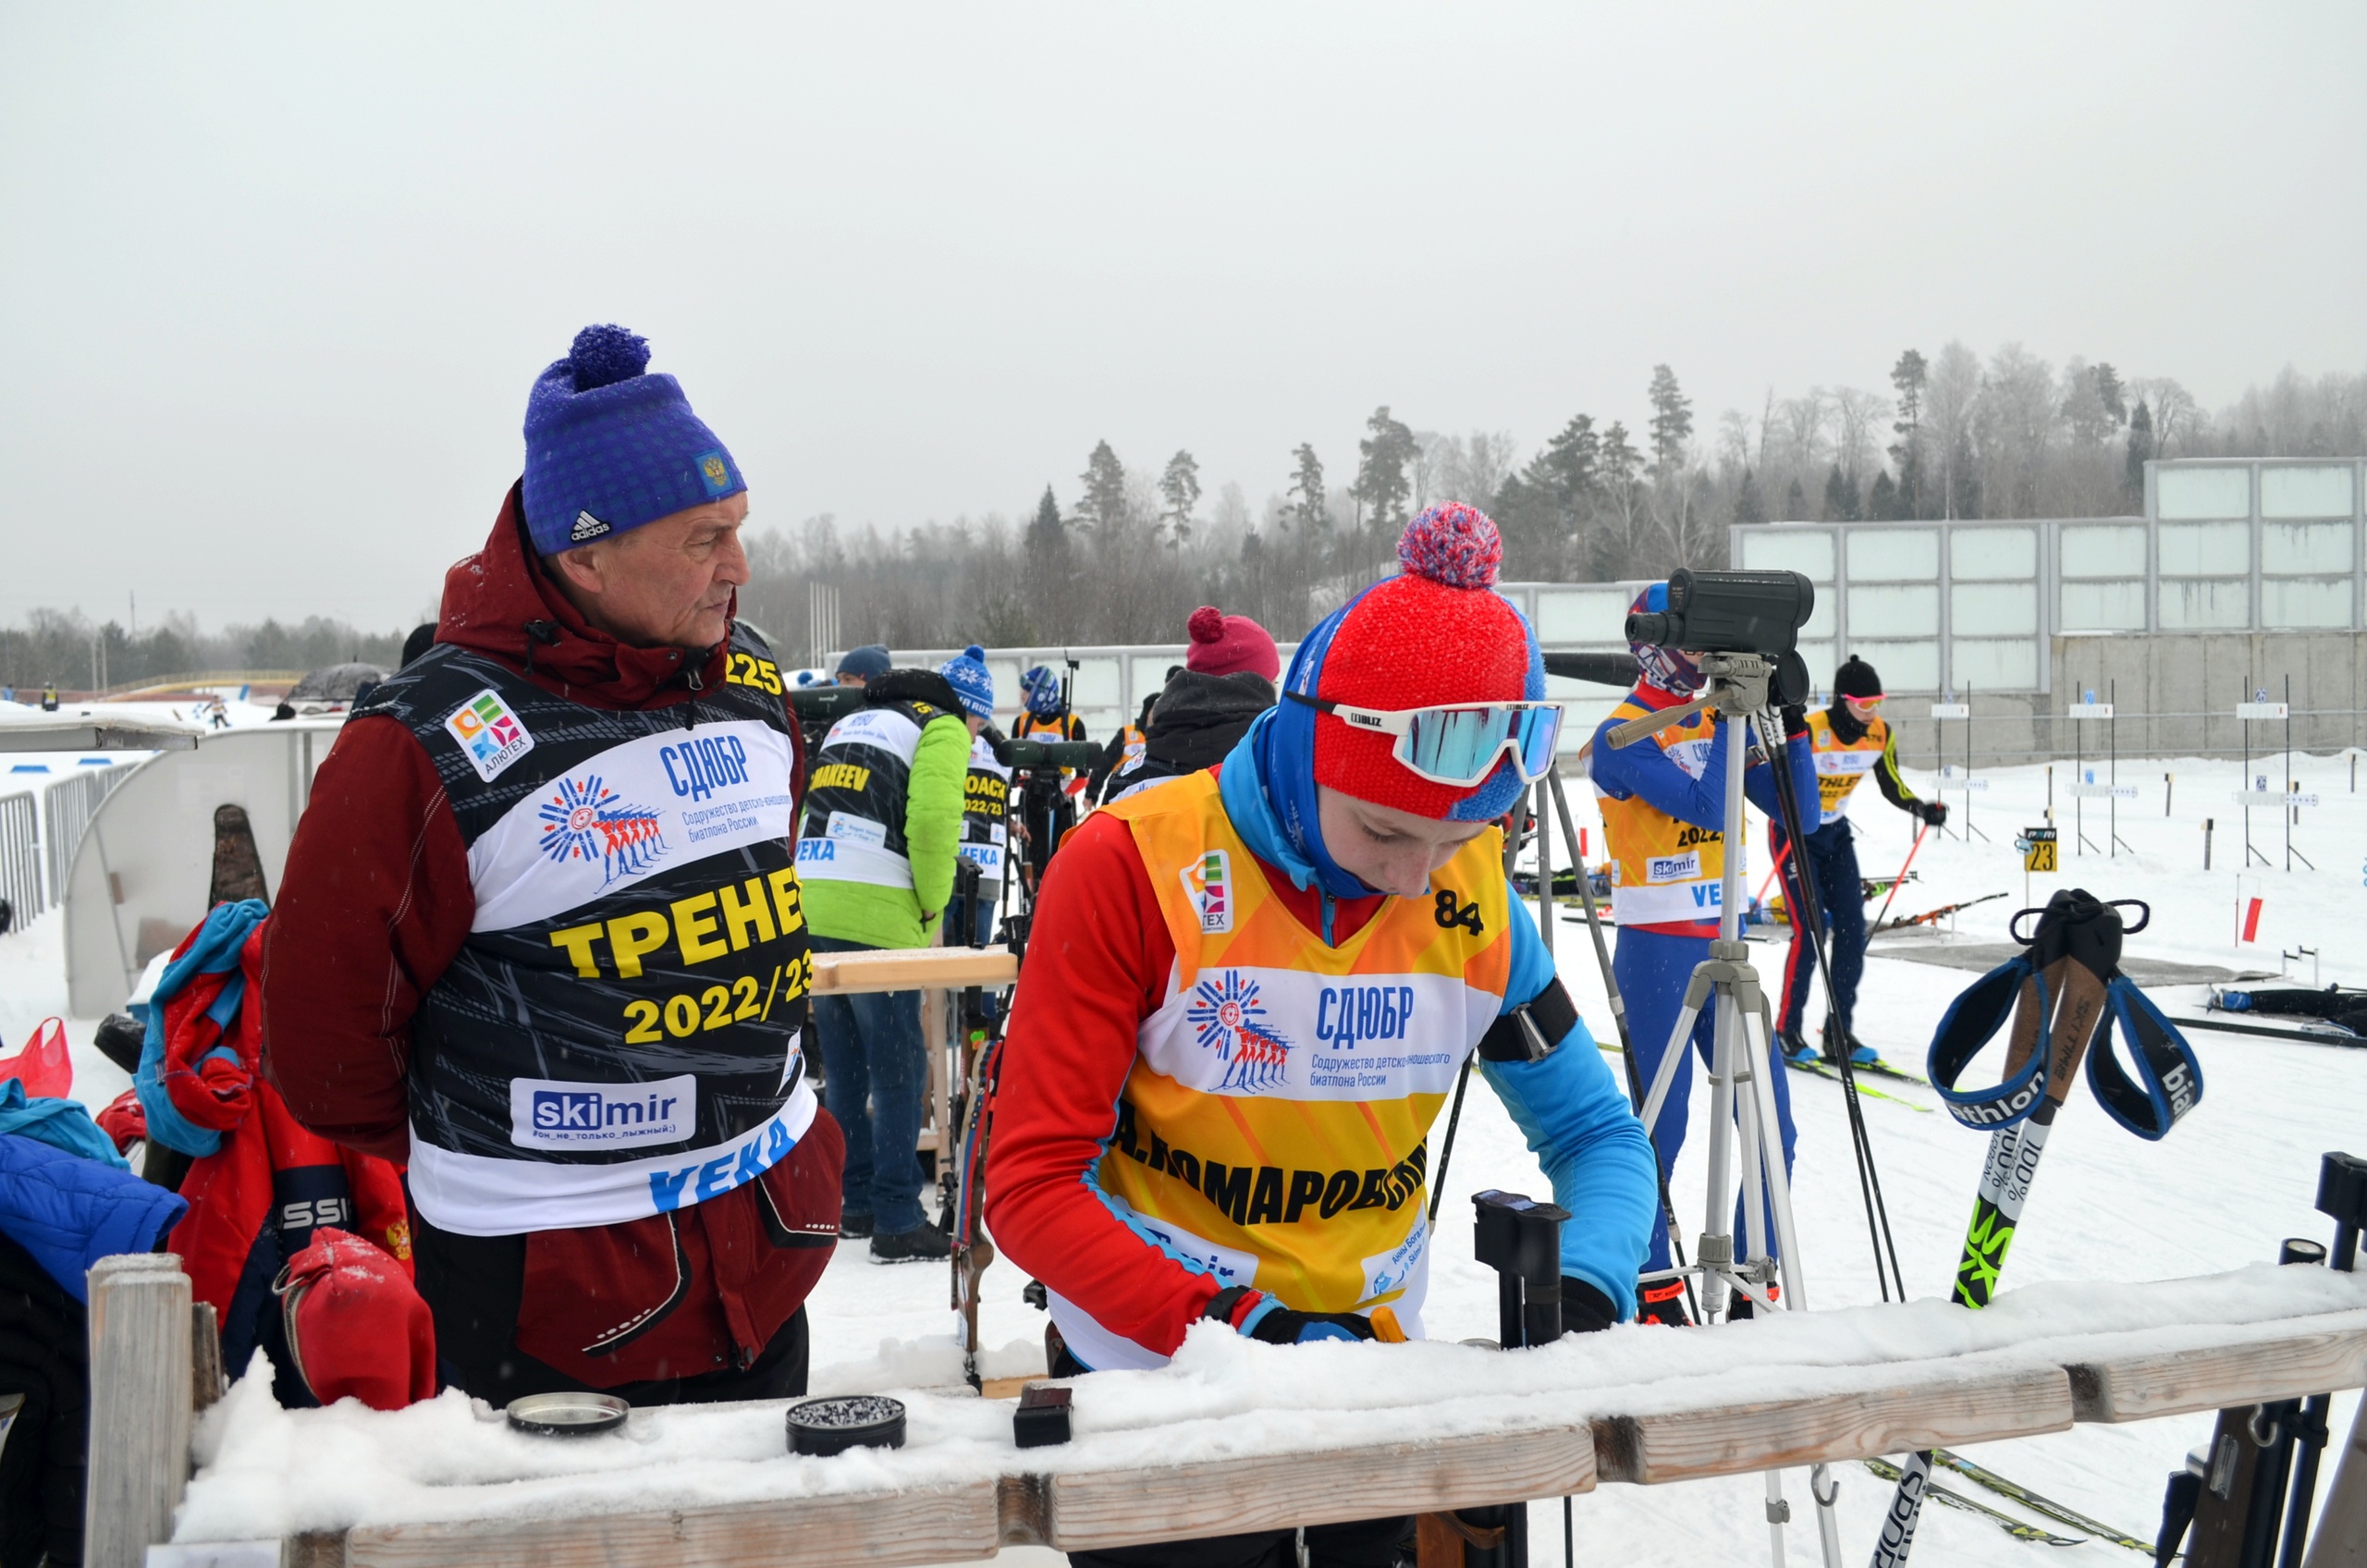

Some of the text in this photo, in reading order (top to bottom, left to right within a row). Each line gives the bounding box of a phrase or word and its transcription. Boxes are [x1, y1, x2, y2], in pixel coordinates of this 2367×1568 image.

[571, 523, 610, 541] adidas
[972, 701, 992, 716] RUSS
[484, 737, 526, 774] АЛЮТЕХ
[659, 735, 749, 802] СДЮБР
[965, 776, 1006, 800] OACH
[682, 802, 738, 826] Содружество
[964, 799, 1002, 816] 022/23
[688, 815, 759, 843] биатлона России
[2030, 844, 2053, 871] 23
[1691, 884, 1722, 907] VE
[549, 865, 803, 979] ТРЕНЕ
[1435, 889, 1484, 937] 84
[623, 948, 813, 1044] 2022/23
[1317, 986, 1414, 1049] СДЮБР
[1311, 1054, 1375, 1072] Содружество
[1309, 1072, 1386, 1087] биатлона России
[534, 1094, 677, 1127] skimir
[1950, 1071, 2045, 1124] athlon
[649, 1116, 796, 1213] VEKA
[2007, 1138, 2043, 1202] 100%
